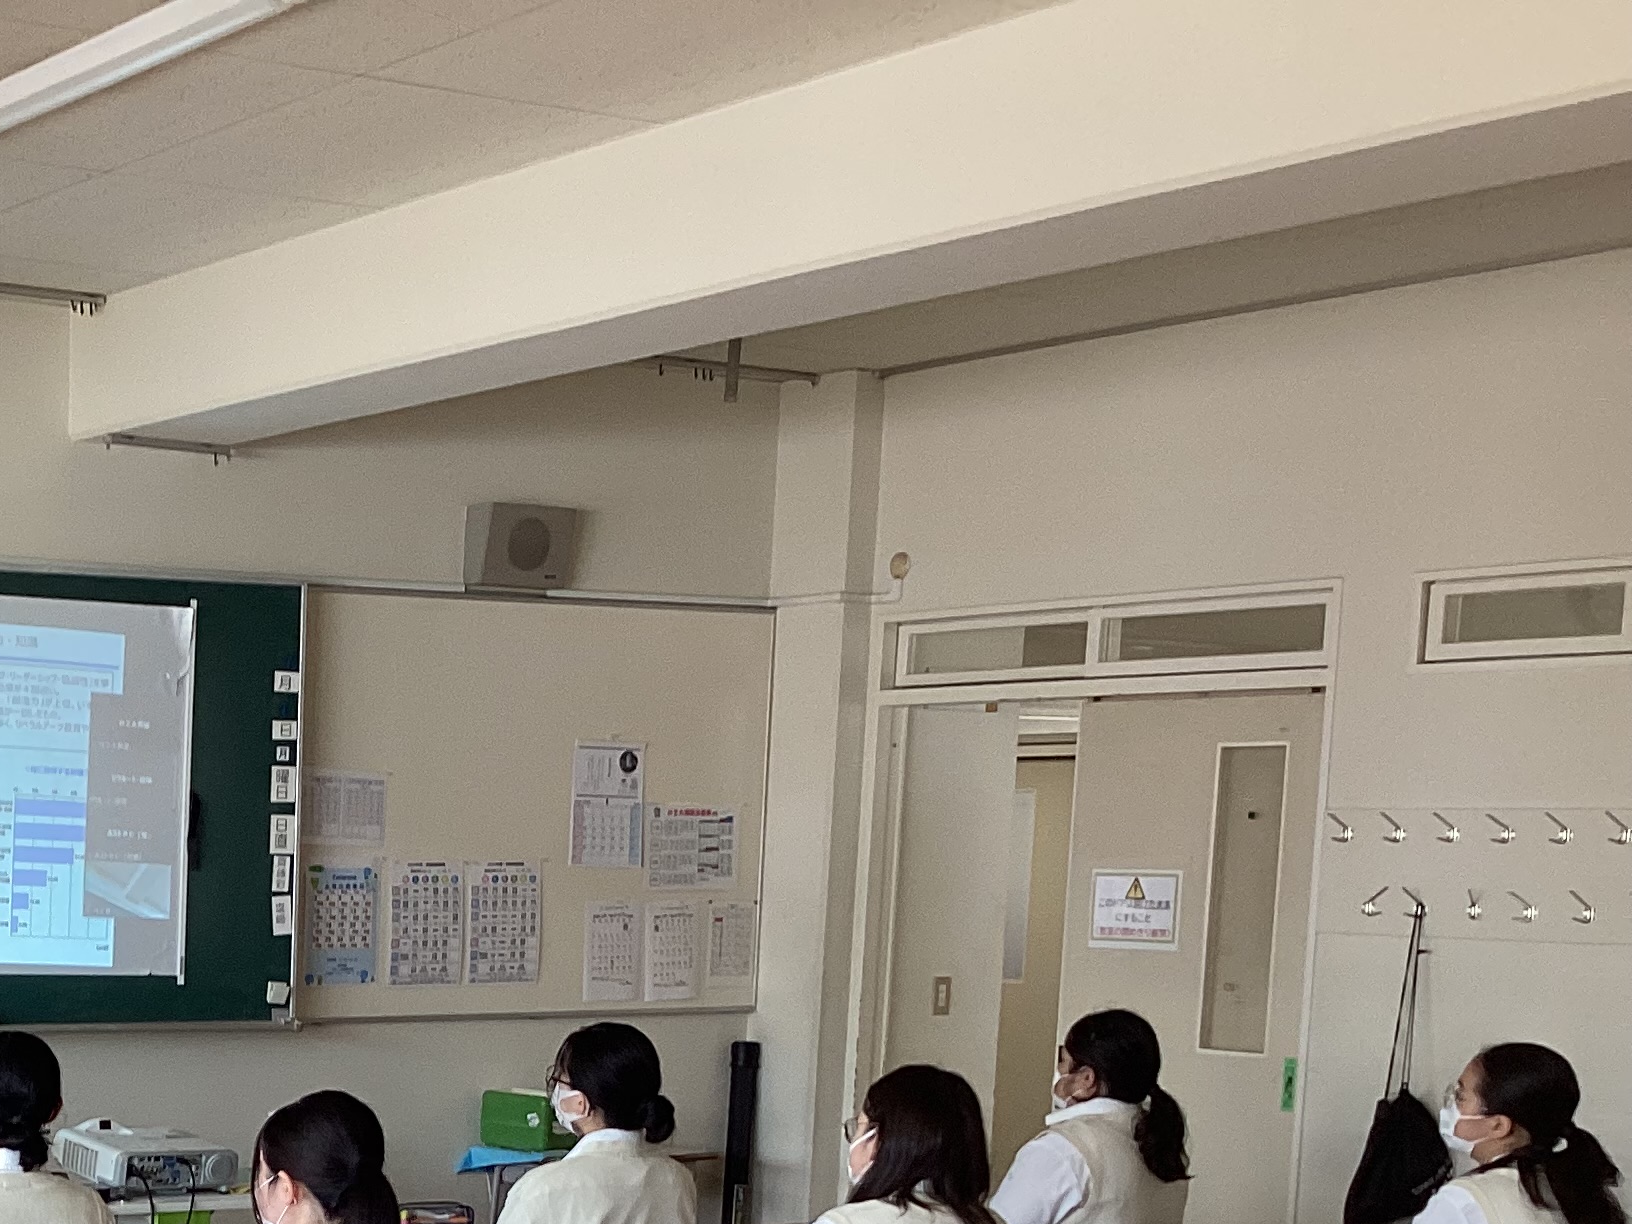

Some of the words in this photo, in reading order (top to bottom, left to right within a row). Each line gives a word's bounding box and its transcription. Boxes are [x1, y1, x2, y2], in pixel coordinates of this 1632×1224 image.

[279, 674, 292, 691] 月
[280, 722, 292, 737] 日
[275, 768, 290, 800] 曜日
